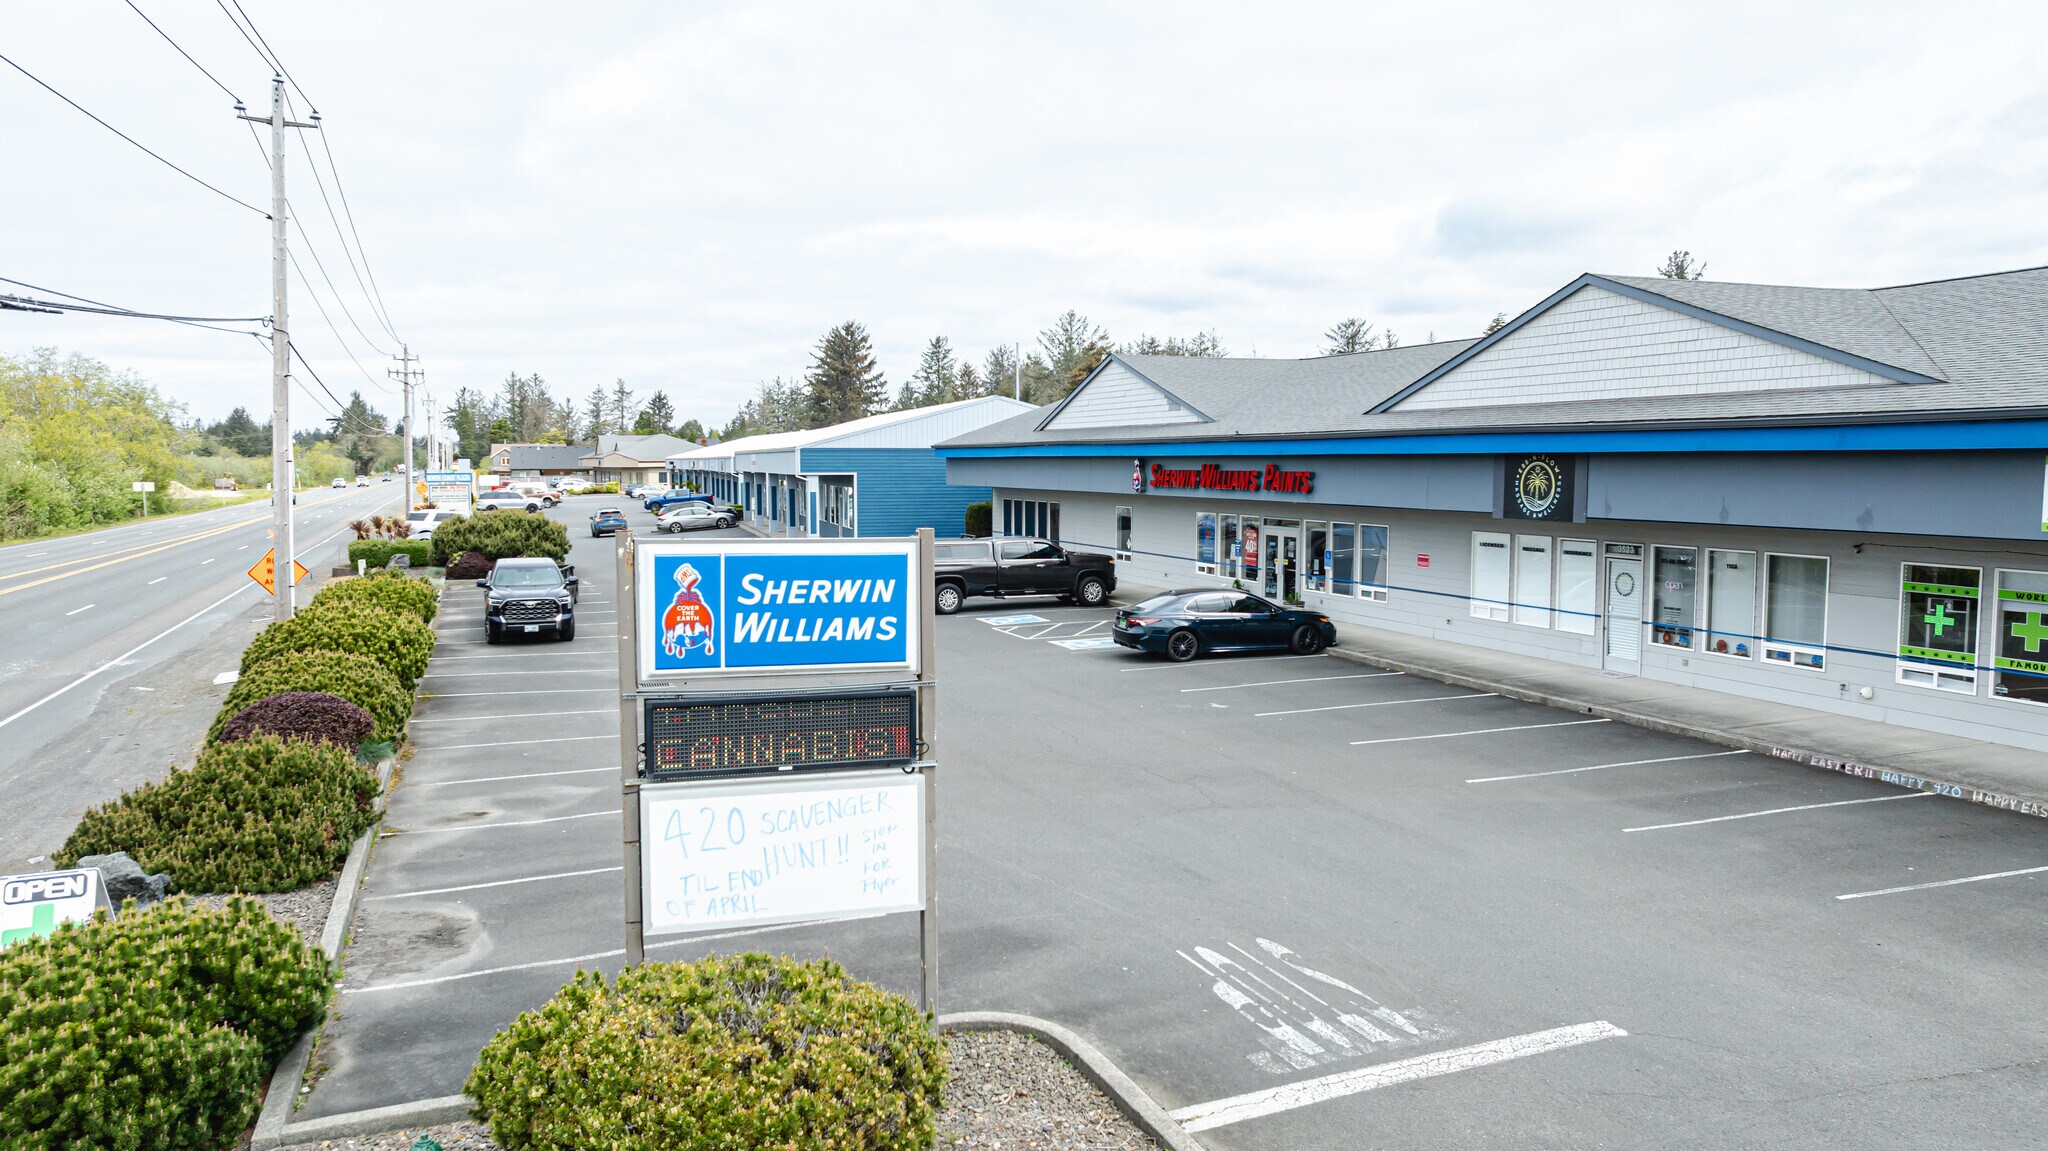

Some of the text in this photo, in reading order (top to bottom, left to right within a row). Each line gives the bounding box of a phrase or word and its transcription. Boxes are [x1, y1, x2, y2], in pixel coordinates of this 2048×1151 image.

[1263, 464, 1313, 493] PAINTS
[1617, 545, 1635, 554] 3523
[737, 573, 895, 605] SHERWIN
[733, 611, 898, 644] WILLIAMS
[1933, 782, 1962, 798] 420
[1972, 790, 2018, 810] HAPPY
[664, 790, 895, 859] 420 SCAVENGER
[861, 824, 898, 843] STOP
[872, 842, 887, 854] IN
[863, 857, 892, 874] FOR
[5, 874, 86, 903] OPEN
[679, 869, 763, 896] TIL END
[666, 894, 769, 919] OF APRIL
